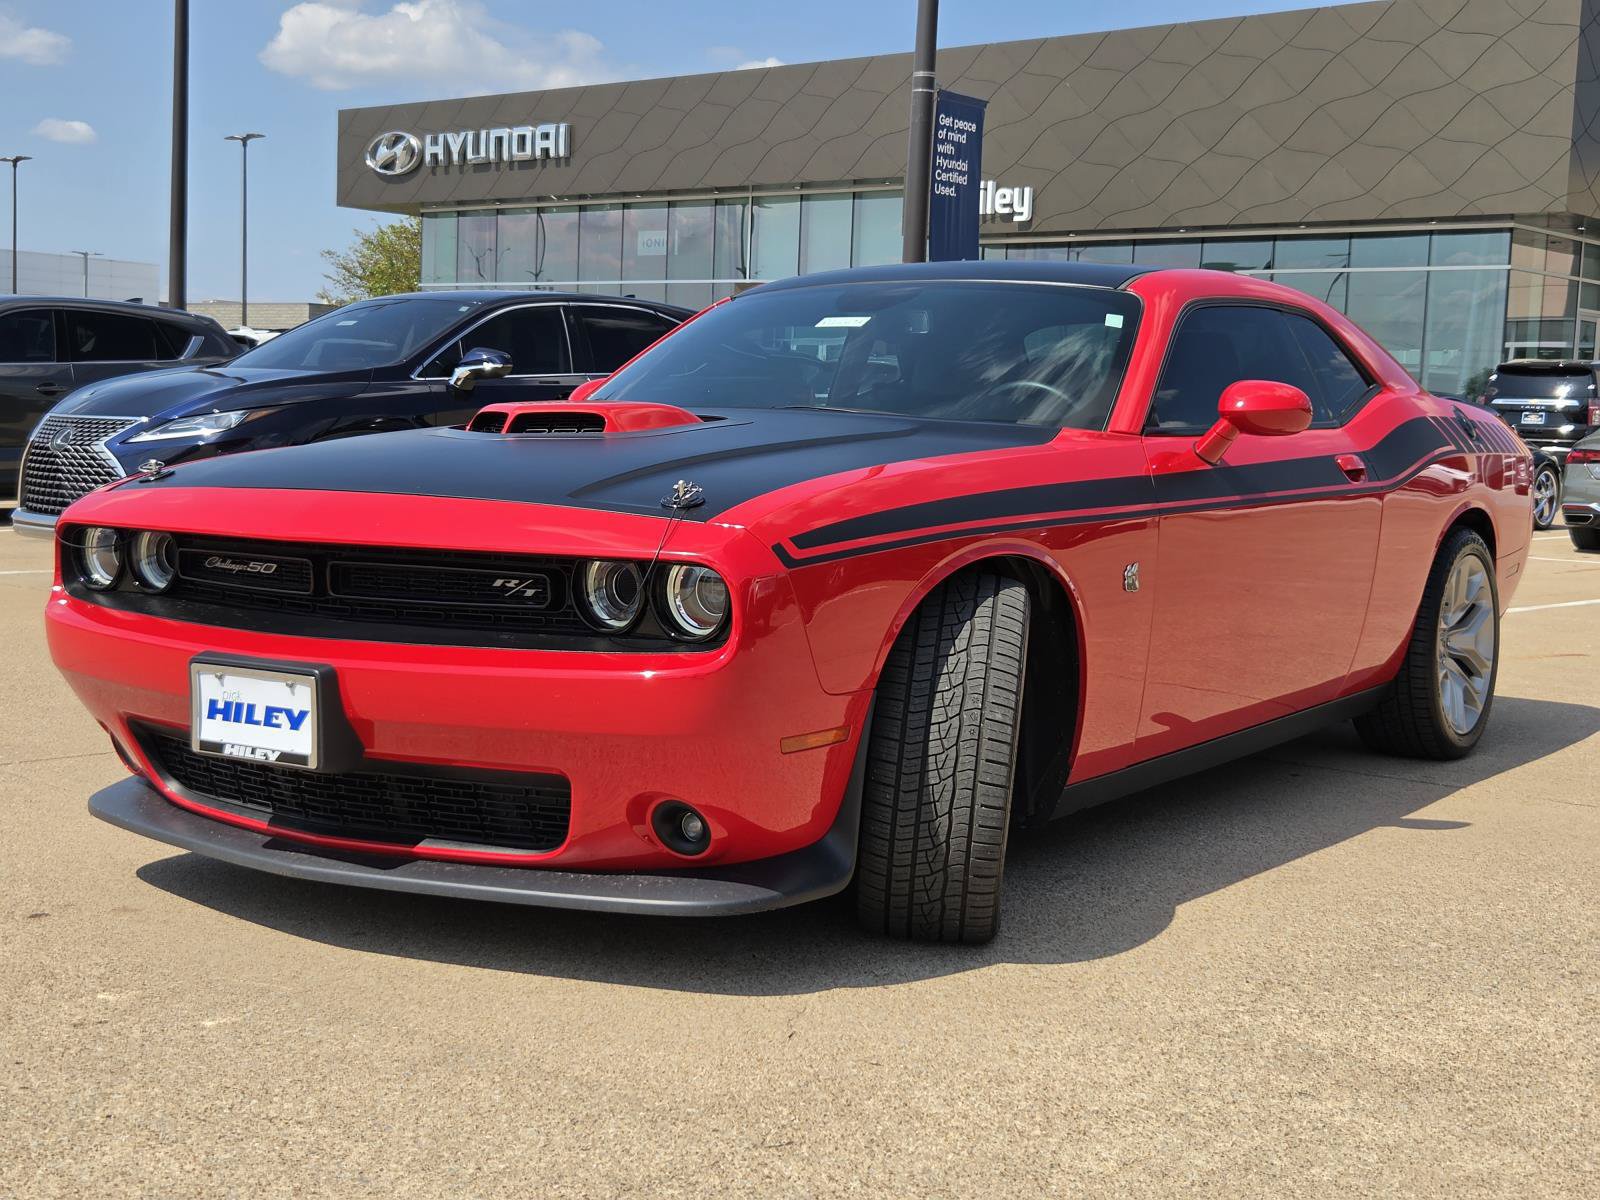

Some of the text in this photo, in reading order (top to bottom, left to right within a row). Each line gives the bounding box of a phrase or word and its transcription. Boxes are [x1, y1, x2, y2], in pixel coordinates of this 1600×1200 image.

[939, 114, 976, 132] Get peace
[424, 122, 571, 167] HYUNDAI
[938, 129, 966, 143] of mind
[937, 143, 954, 154] with
[936, 156, 968, 171] Hyundai
[935, 170, 968, 185] Certified
[934, 183, 956, 196] Used.
[979, 180, 1033, 222] iley
[205, 556, 278, 575] Challenger 50
[492, 579, 543, 597] R/T
[206, 698, 310, 731] HILEY
[222, 743, 281, 761] HILEY
